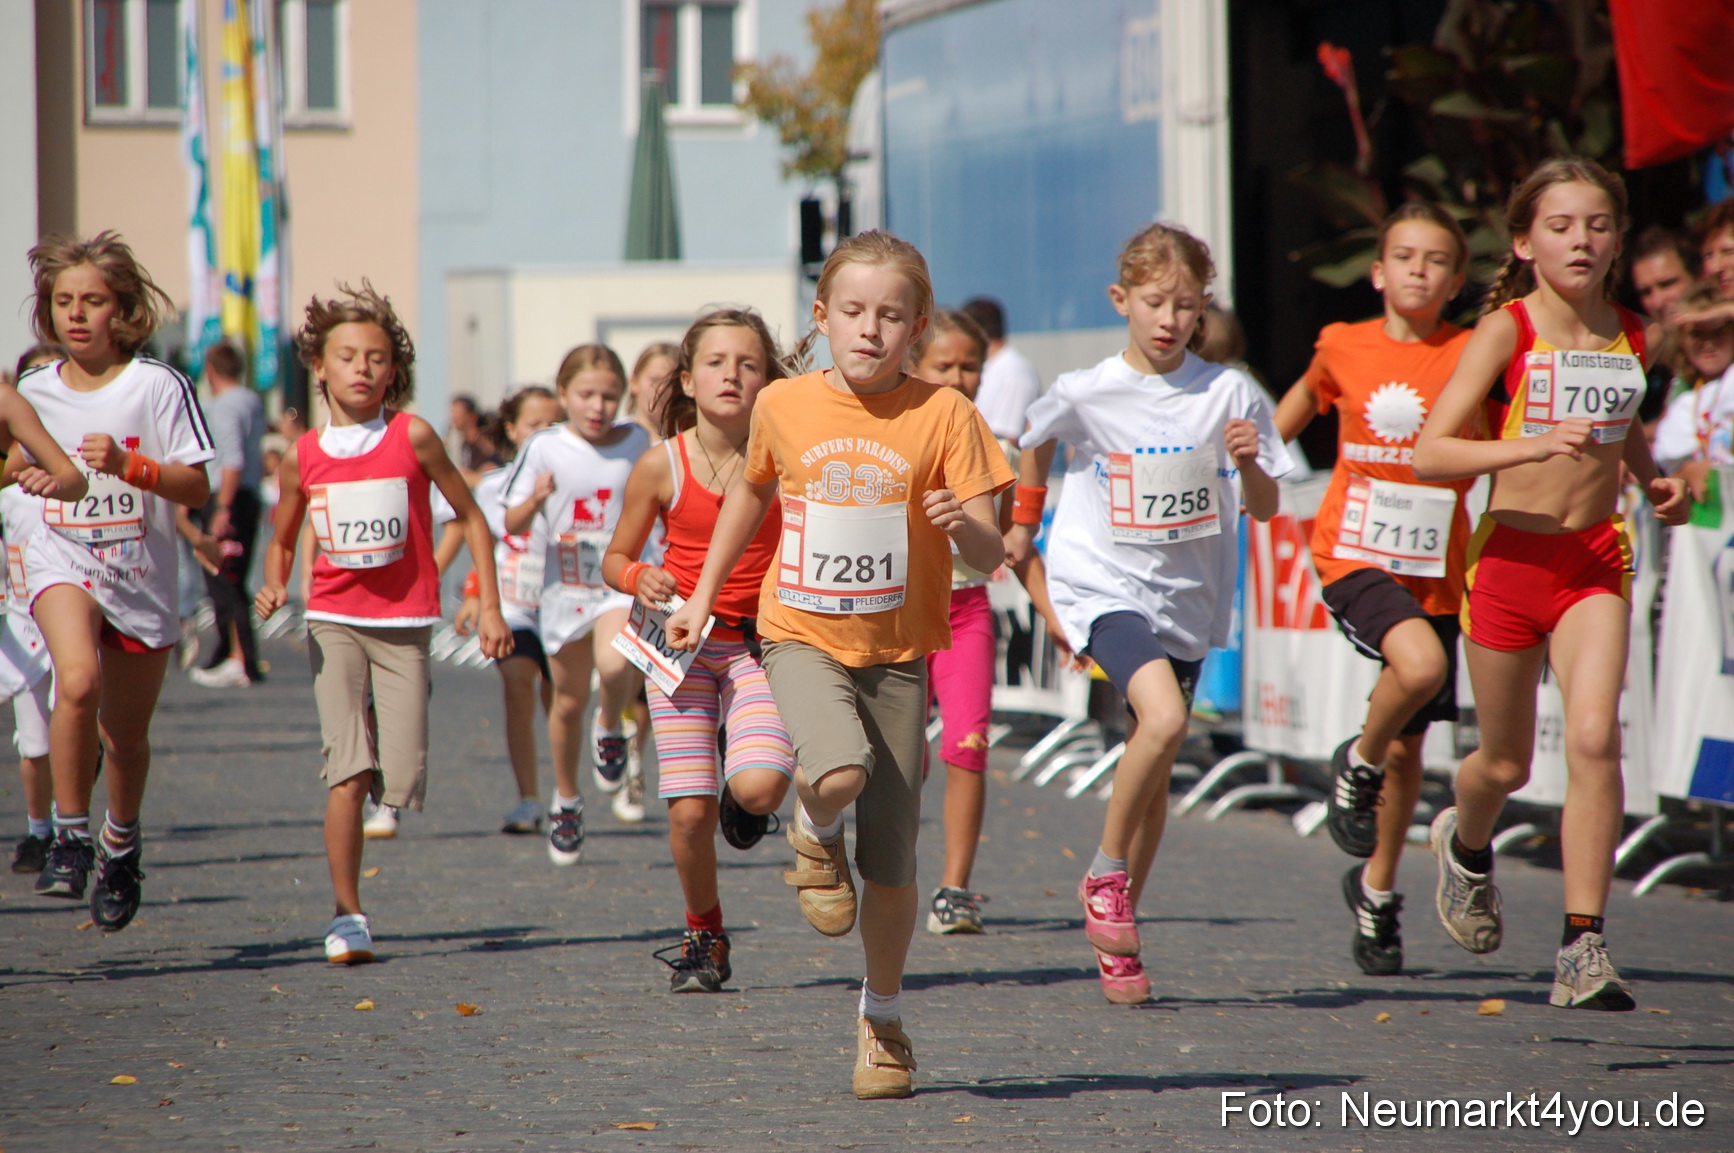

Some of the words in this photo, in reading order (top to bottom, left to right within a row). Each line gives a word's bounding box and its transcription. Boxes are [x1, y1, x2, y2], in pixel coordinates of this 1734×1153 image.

[1562, 351, 1632, 370] Konstanze
[1532, 379, 1548, 393] K3
[1564, 386, 1637, 414] 7097
[800, 438, 854, 468] SURFER'S
[856, 438, 911, 475] PARADISE
[822, 460, 884, 505] 63
[1142, 487, 1211, 519] 7258
[1373, 489, 1413, 510] Helen
[338, 517, 402, 544] 7290
[1373, 521, 1438, 551] 7113
[812, 552, 893, 584] 7281
[779, 588, 823, 606] BOCK
[855, 592, 904, 606] PFLEIDERER
